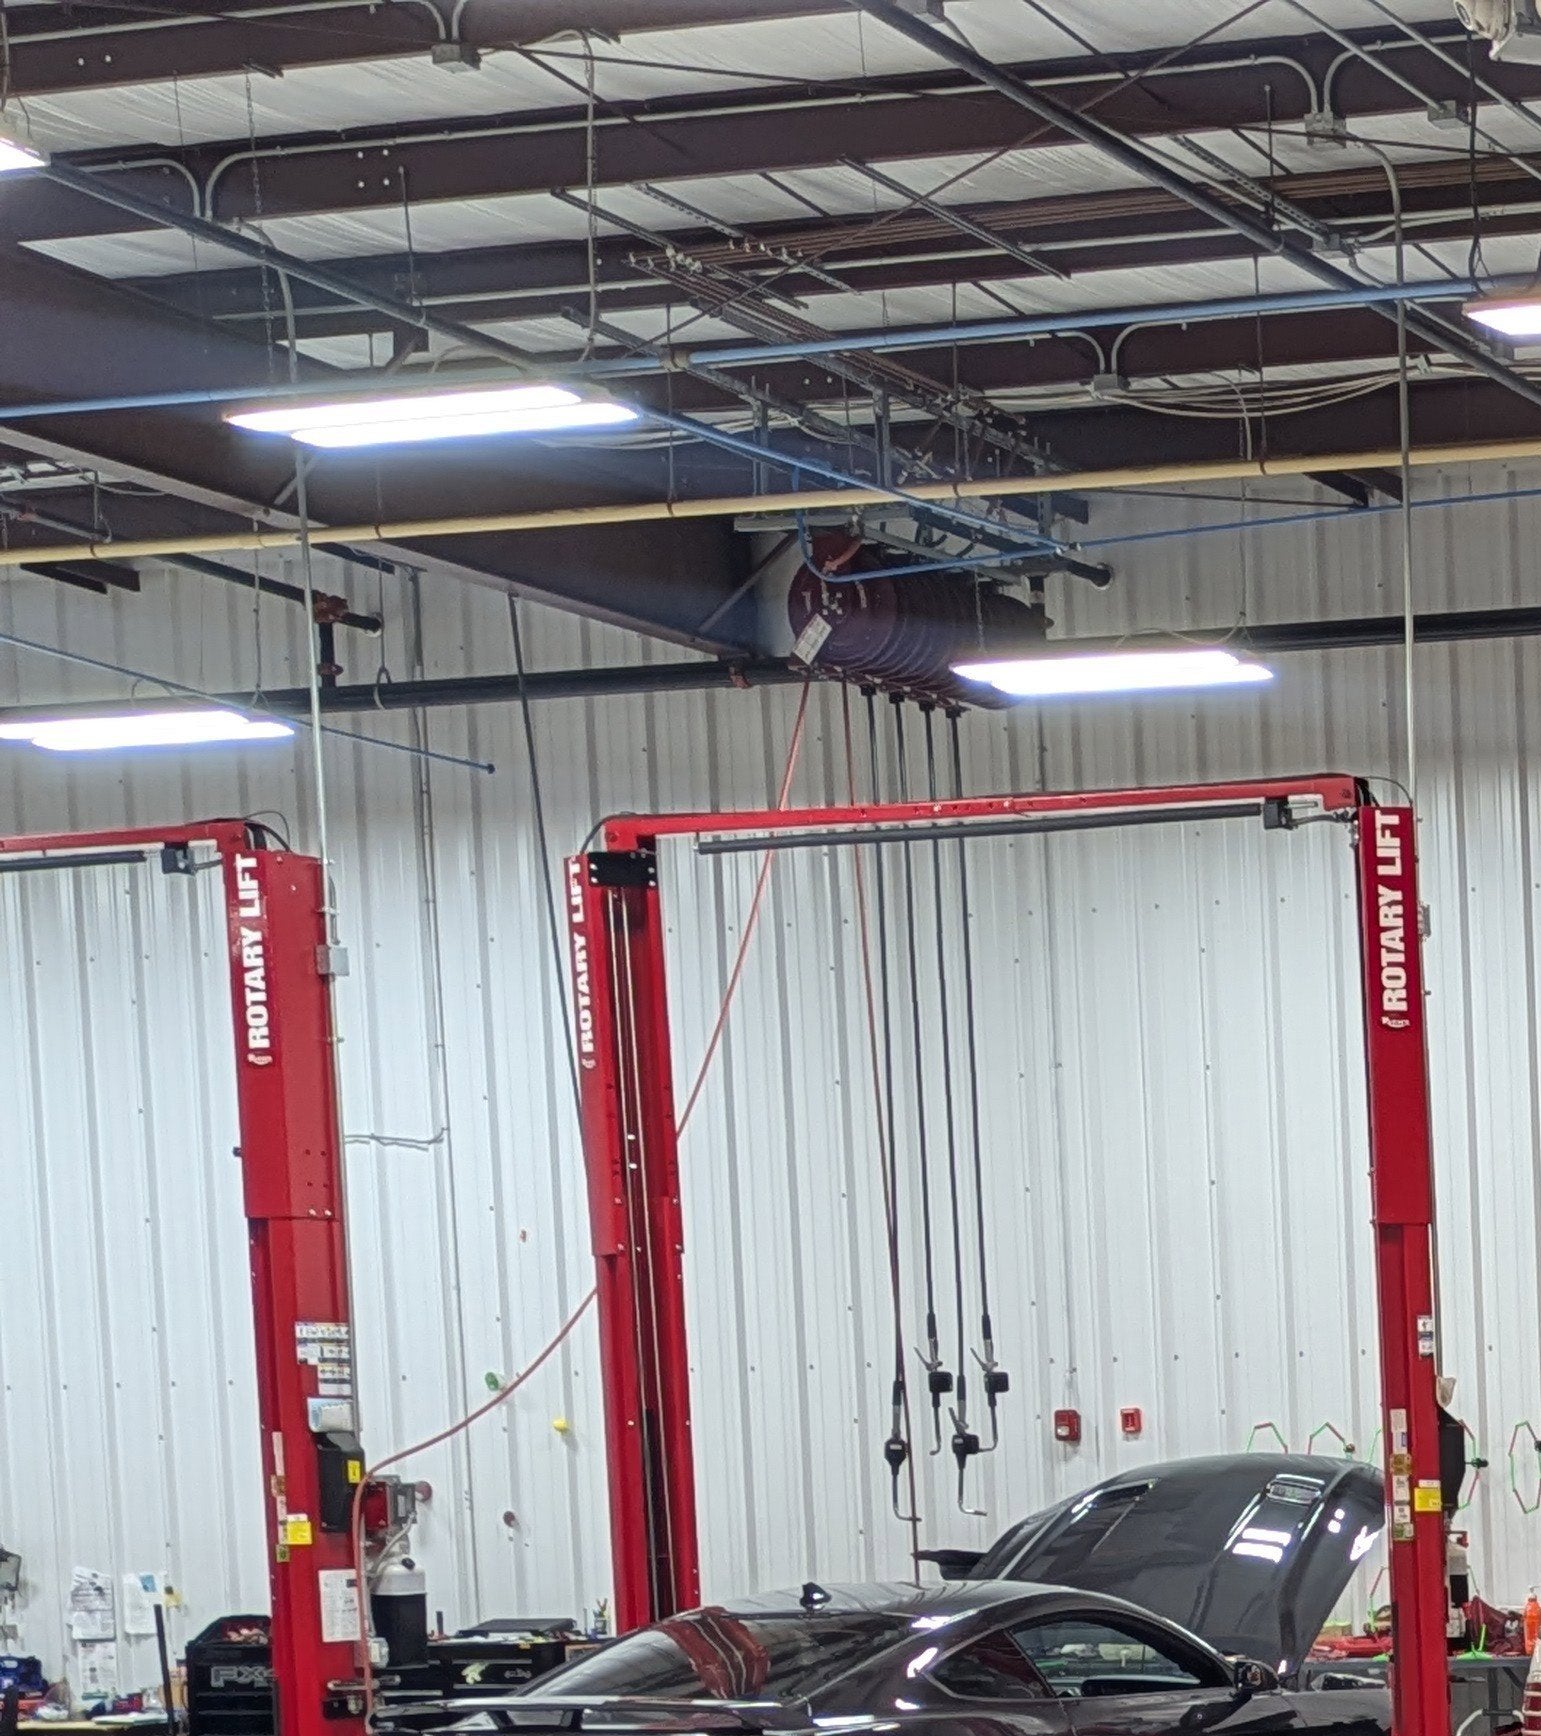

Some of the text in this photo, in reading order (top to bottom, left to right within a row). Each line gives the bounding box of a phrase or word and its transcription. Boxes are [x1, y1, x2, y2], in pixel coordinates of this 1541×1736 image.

[1375, 809, 1403, 876] LIFT
[236, 853, 271, 1049] ROTARY LIFT
[569, 858, 595, 1053] ROTARY LIFT
[1377, 883, 1408, 1012] ROTARY
